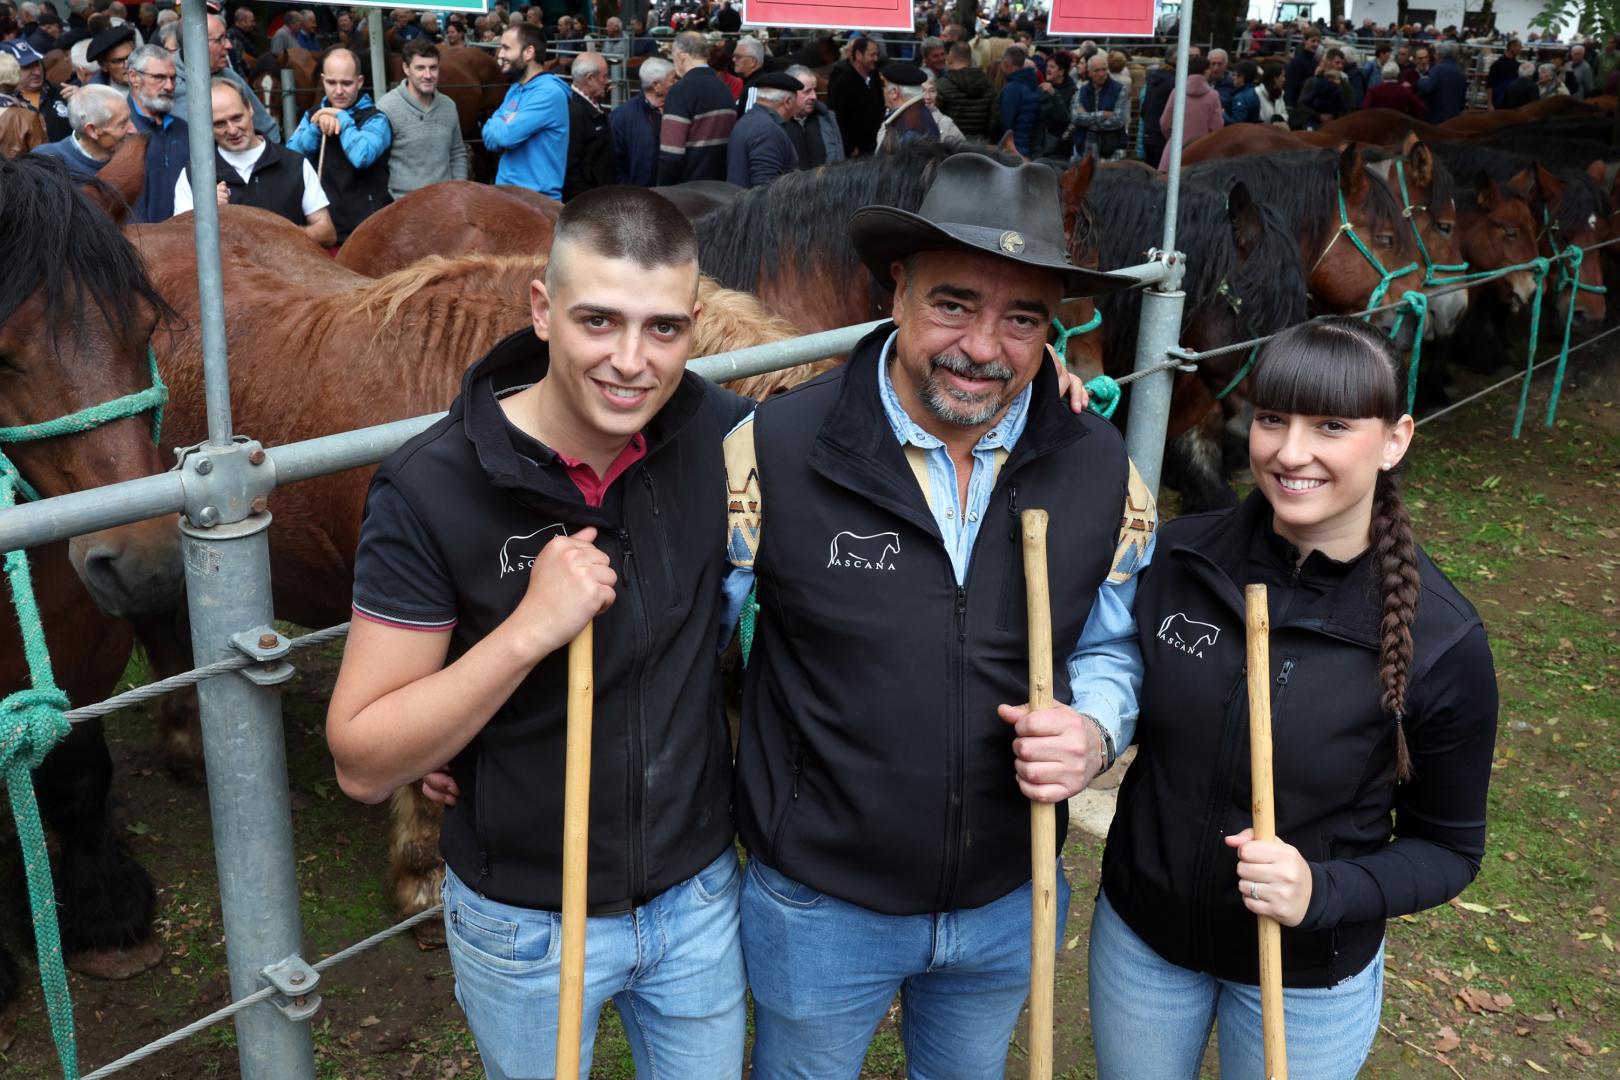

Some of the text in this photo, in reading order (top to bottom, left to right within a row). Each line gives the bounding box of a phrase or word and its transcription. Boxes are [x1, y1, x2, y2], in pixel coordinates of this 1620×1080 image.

[507, 559, 535, 573] ASC
[834, 558, 896, 571] ASCANA
[1159, 633, 1203, 659] ASCANA
